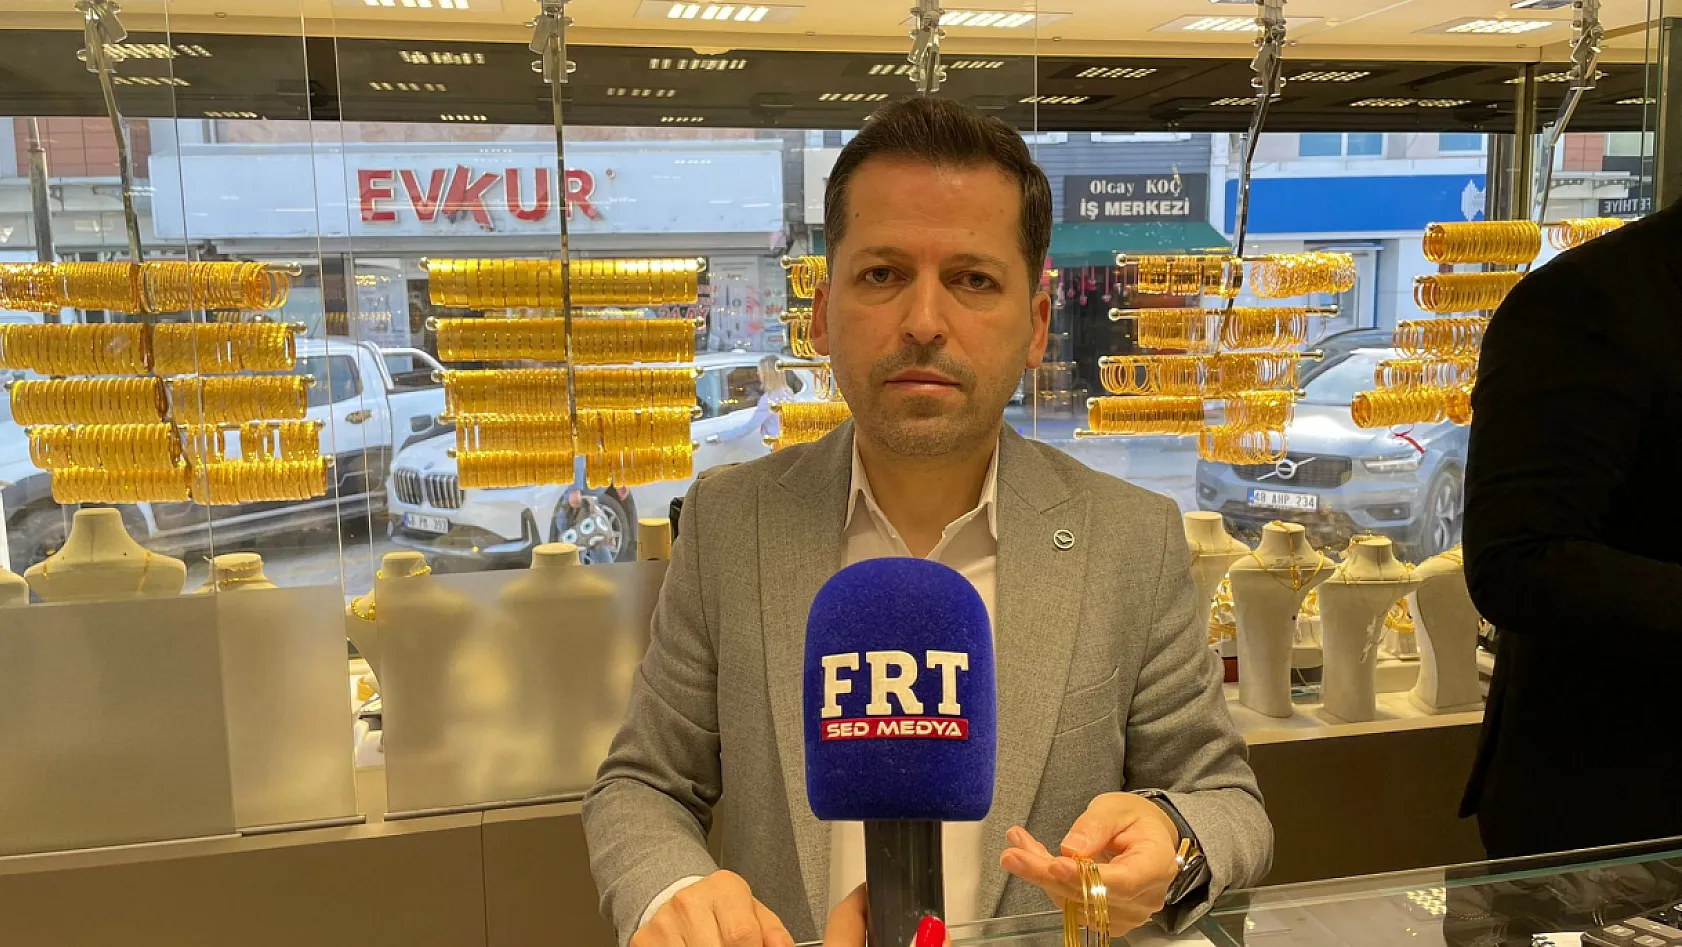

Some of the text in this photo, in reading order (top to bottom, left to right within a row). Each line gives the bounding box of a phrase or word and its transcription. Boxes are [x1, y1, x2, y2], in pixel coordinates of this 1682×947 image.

[357, 164, 602, 232] EVKUR
[1090, 179, 1182, 197] Olcay KOÇ
[1080, 197, 1190, 220] İŞ MERKEZİ
[821, 650, 969, 719] FRT
[826, 721, 962, 738] SED MEDYA
